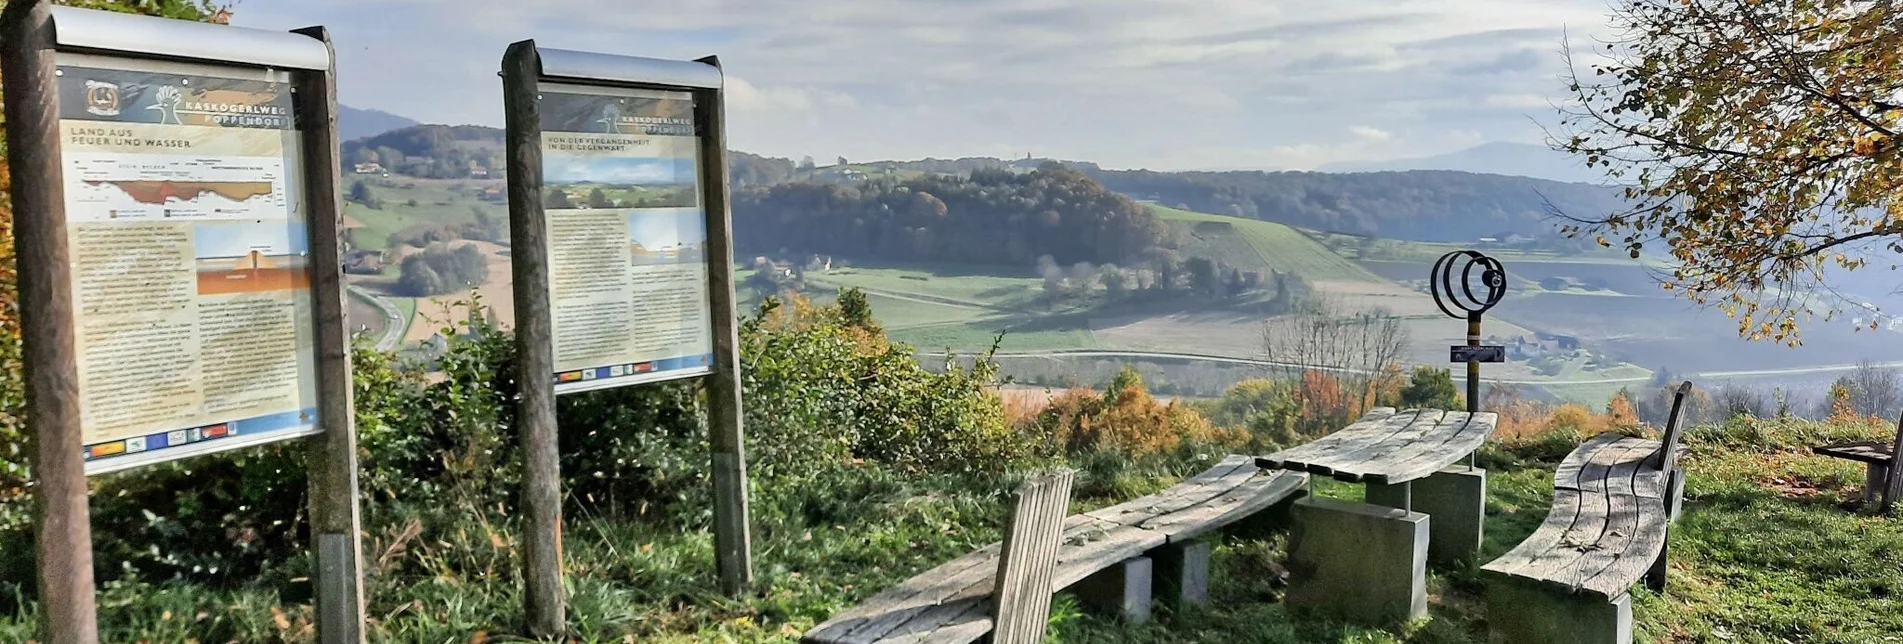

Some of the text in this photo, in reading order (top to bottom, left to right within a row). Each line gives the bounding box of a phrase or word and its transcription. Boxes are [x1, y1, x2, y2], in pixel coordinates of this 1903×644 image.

[71, 127, 132, 137] LAND AUS
[71, 137, 191, 148] FEUER UND WASSER
[586, 138, 651, 146] VERGANGENHEIT
